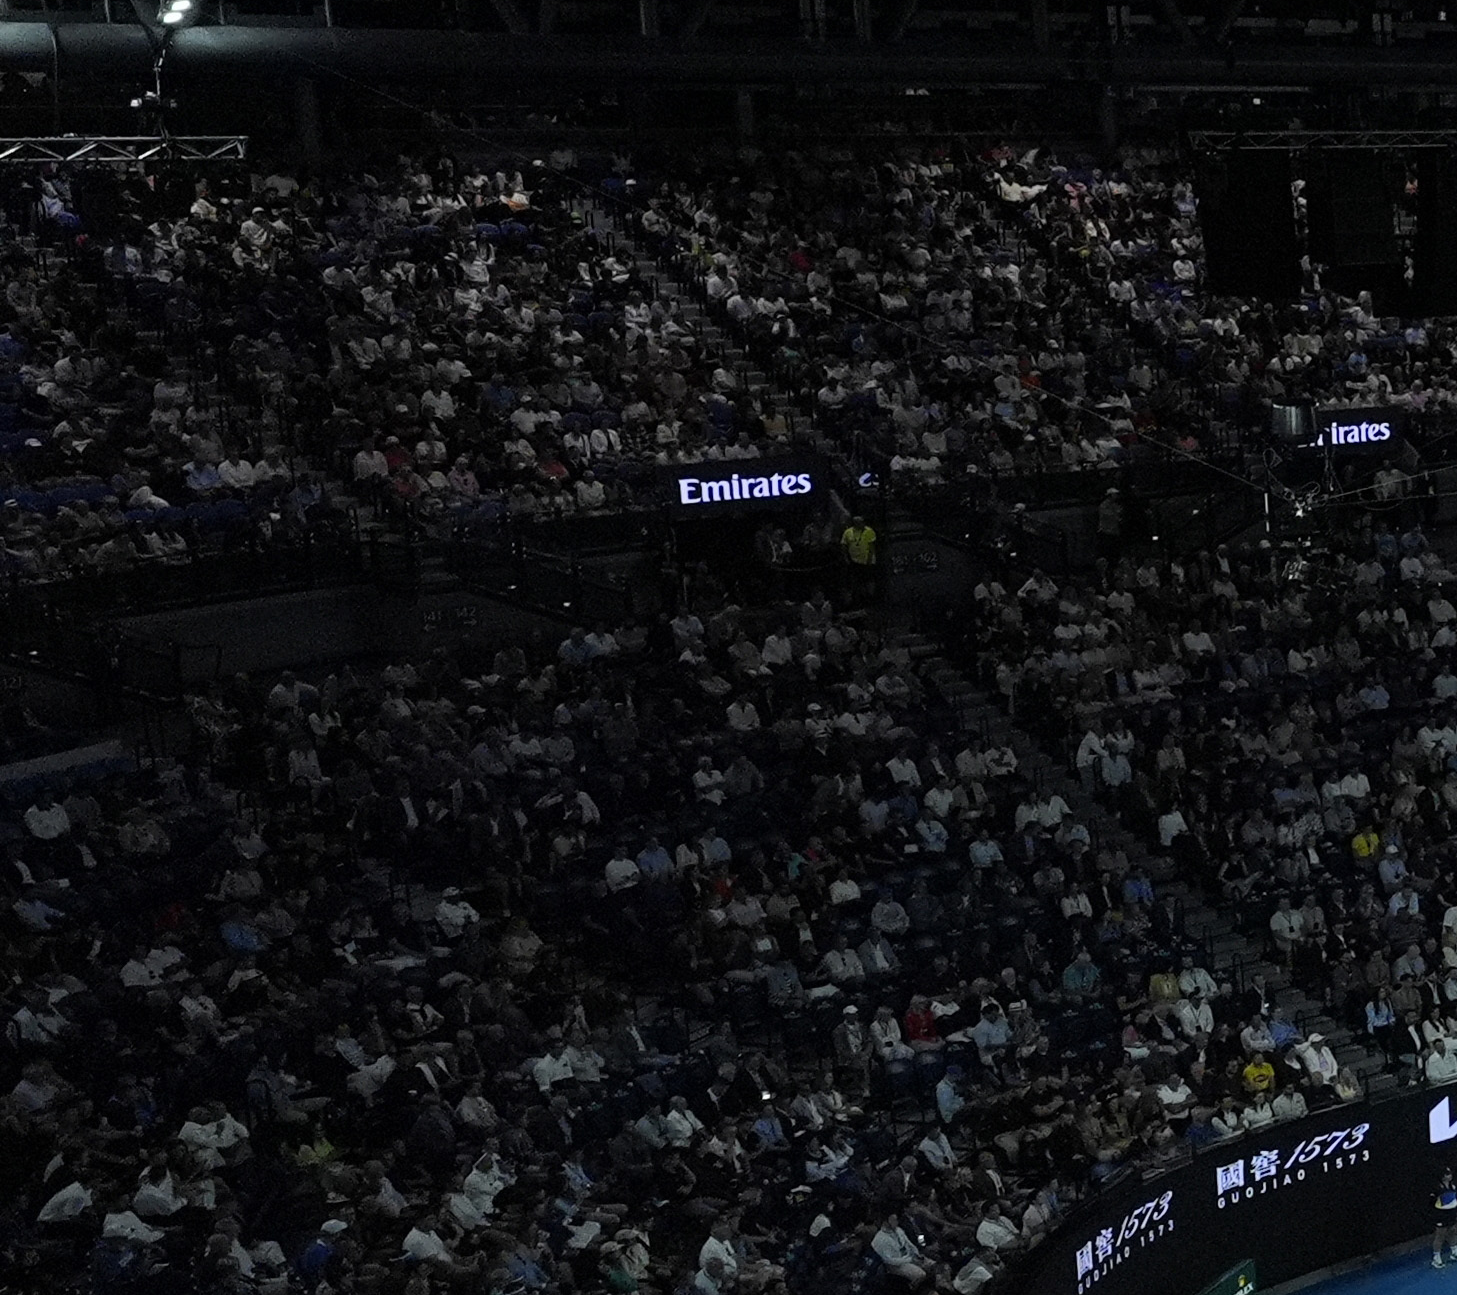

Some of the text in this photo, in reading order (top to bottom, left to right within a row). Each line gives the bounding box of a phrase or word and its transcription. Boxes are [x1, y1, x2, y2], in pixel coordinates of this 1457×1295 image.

[1297, 422, 1390, 447] irates
[679, 473, 811, 504] Emirates
[1217, 1150, 1370, 1209] GUOJIAO 1573
[1078, 1220, 1174, 1295] GUOJIAO 1573
